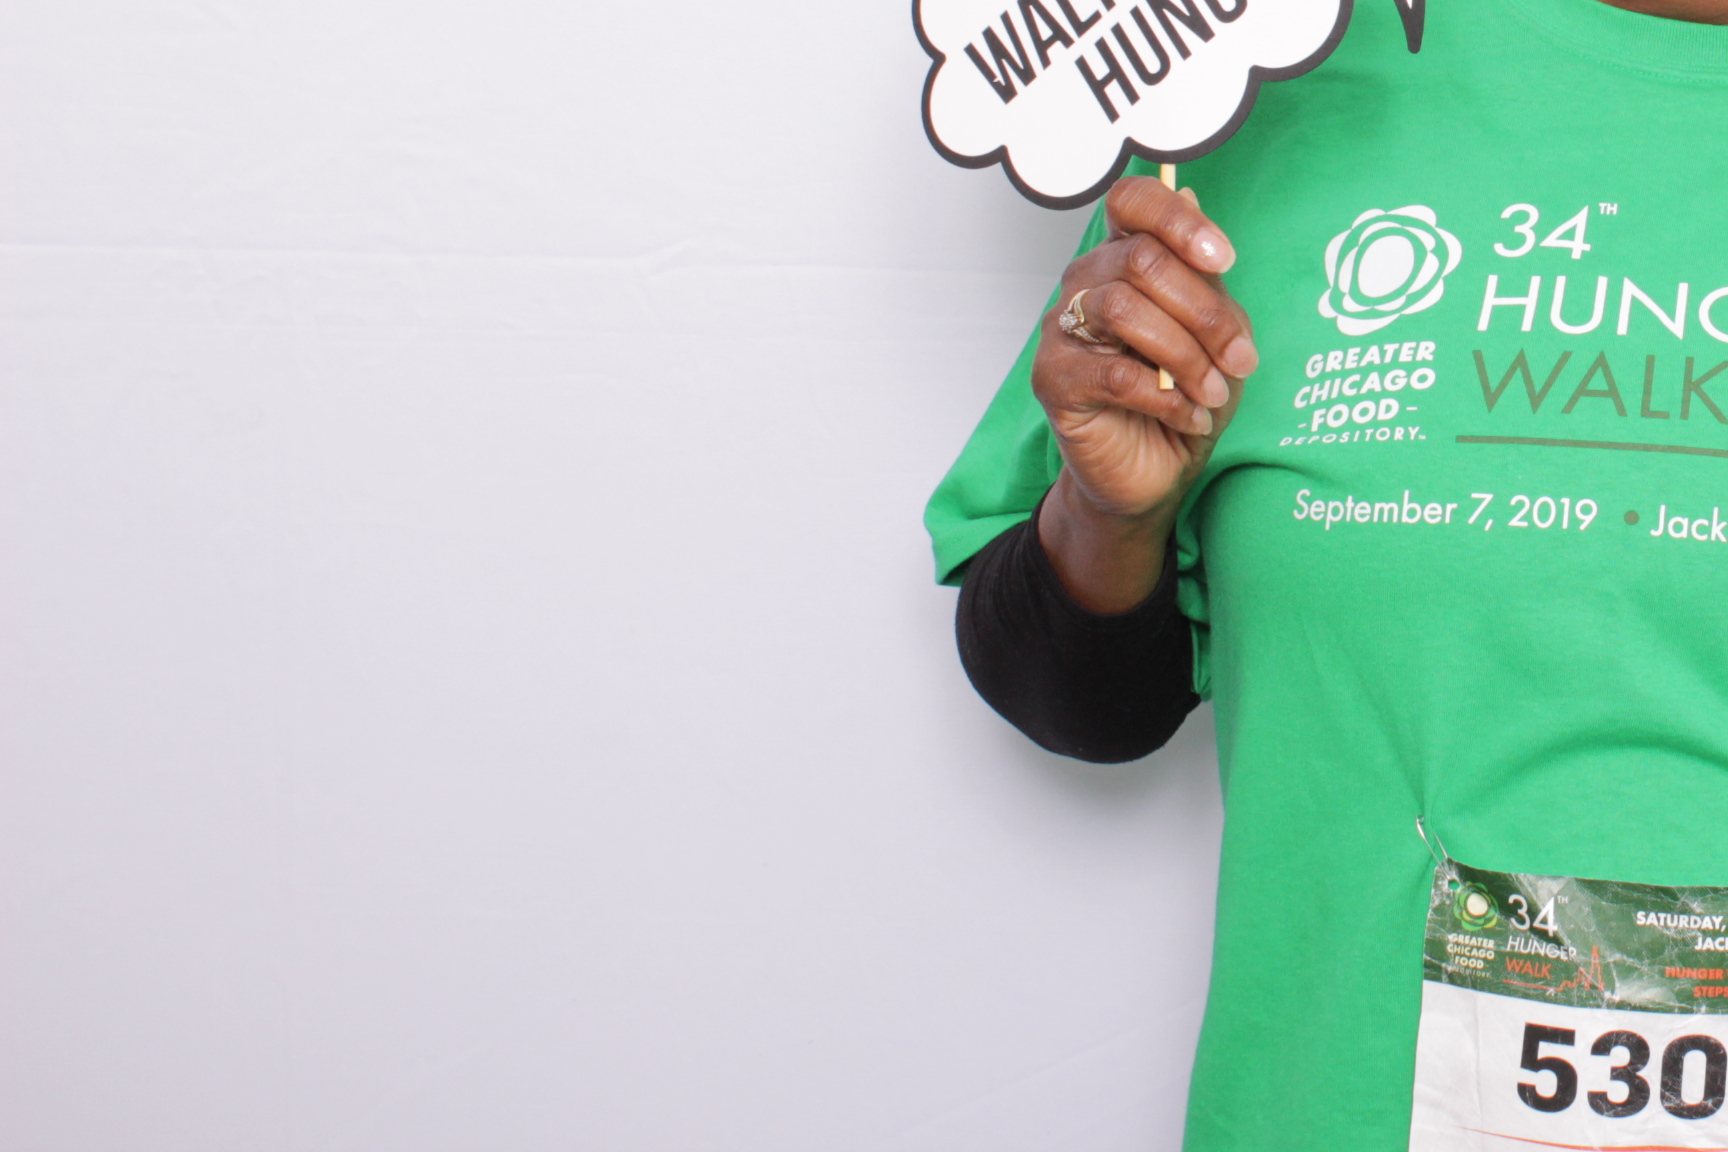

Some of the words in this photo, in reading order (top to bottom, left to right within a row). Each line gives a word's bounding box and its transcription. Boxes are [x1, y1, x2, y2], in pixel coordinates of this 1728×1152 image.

[1305, 341, 1436, 379] GREATER
[1294, 367, 1436, 409] CHICAGO
[1293, 489, 1458, 531] September
[1468, 492, 1494, 531] 7,
[1507, 495, 1598, 531] 2019
[1636, 910, 1726, 932] SATURDAY,
[1447, 943, 1495, 960] CHICAGO
[1449, 933, 1495, 949] GREATER
[1506, 935, 1577, 961] HUNGER
[1454, 956, 1485, 970] FOOD
[1505, 957, 1553, 979] WALK
[1664, 966, 1724, 980] HUNGER
